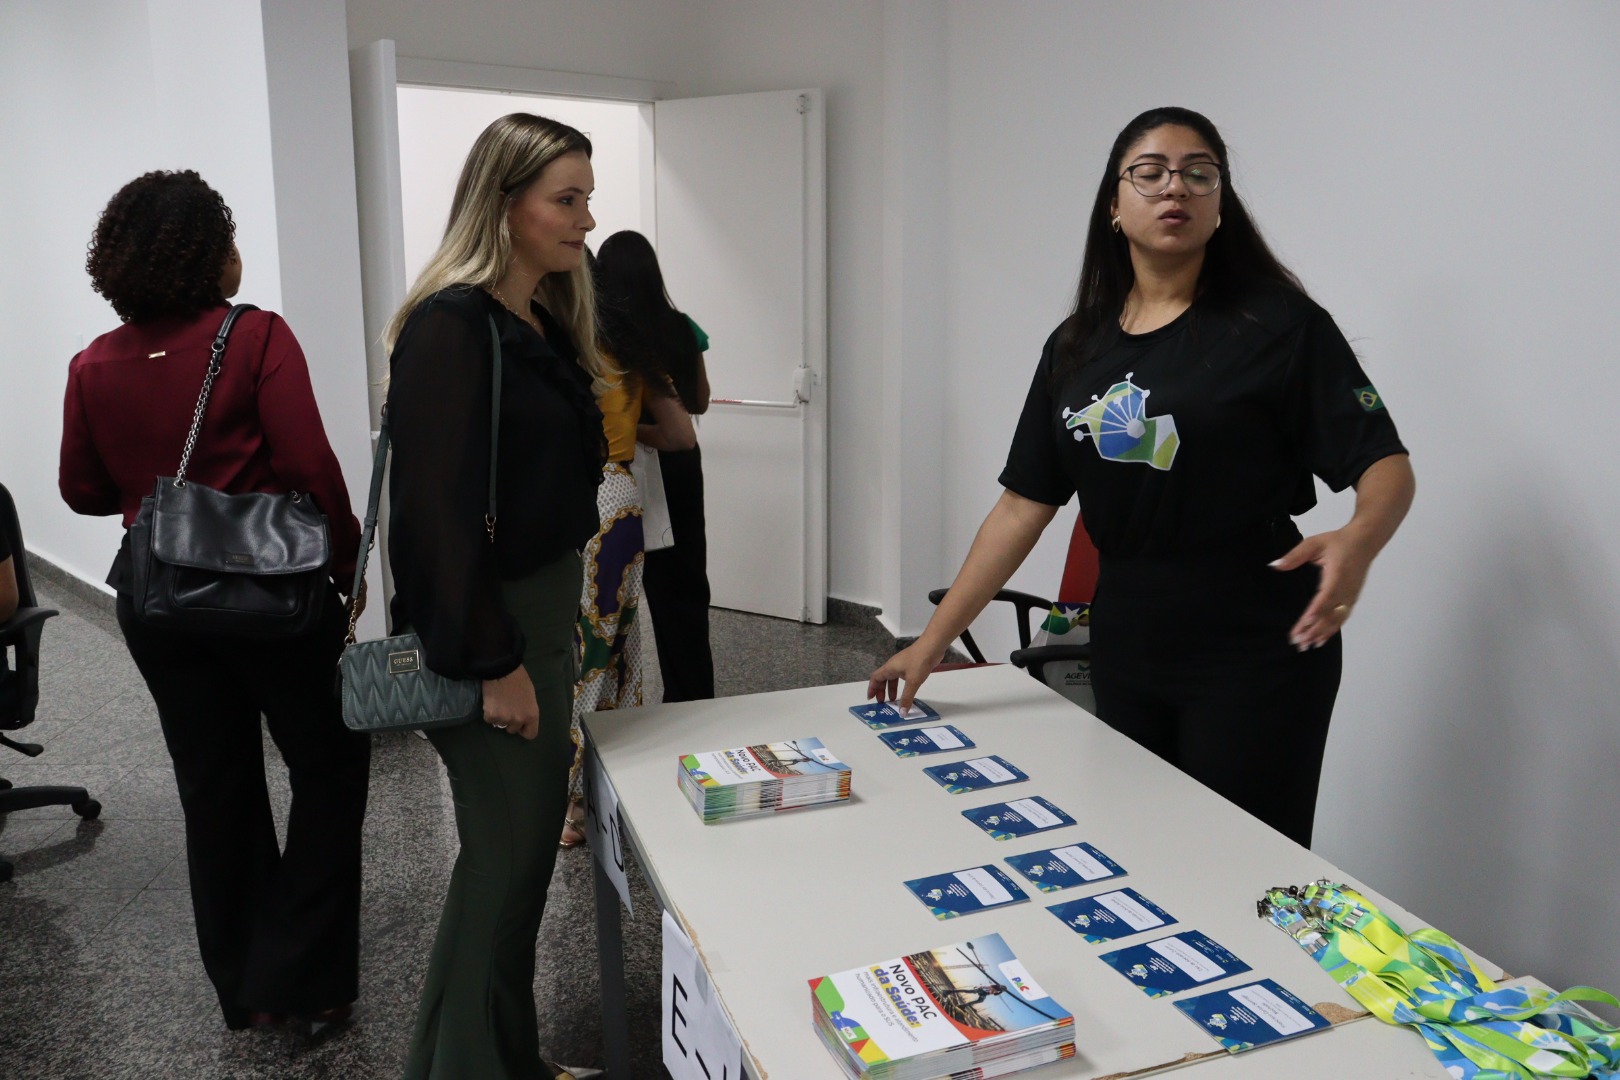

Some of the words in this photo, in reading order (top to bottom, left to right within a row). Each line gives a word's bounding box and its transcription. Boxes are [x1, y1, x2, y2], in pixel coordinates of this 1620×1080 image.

[863, 971, 873, 983] mais
[1011, 976, 1030, 992] PAC
[874, 968, 890, 985] da
[885, 985, 920, 1026] Saúde:
[889, 964, 915, 995] Novo
[911, 996, 938, 1020] PAC
[873, 1001, 885, 1014] para
[884, 1016, 895, 1027] SUS
